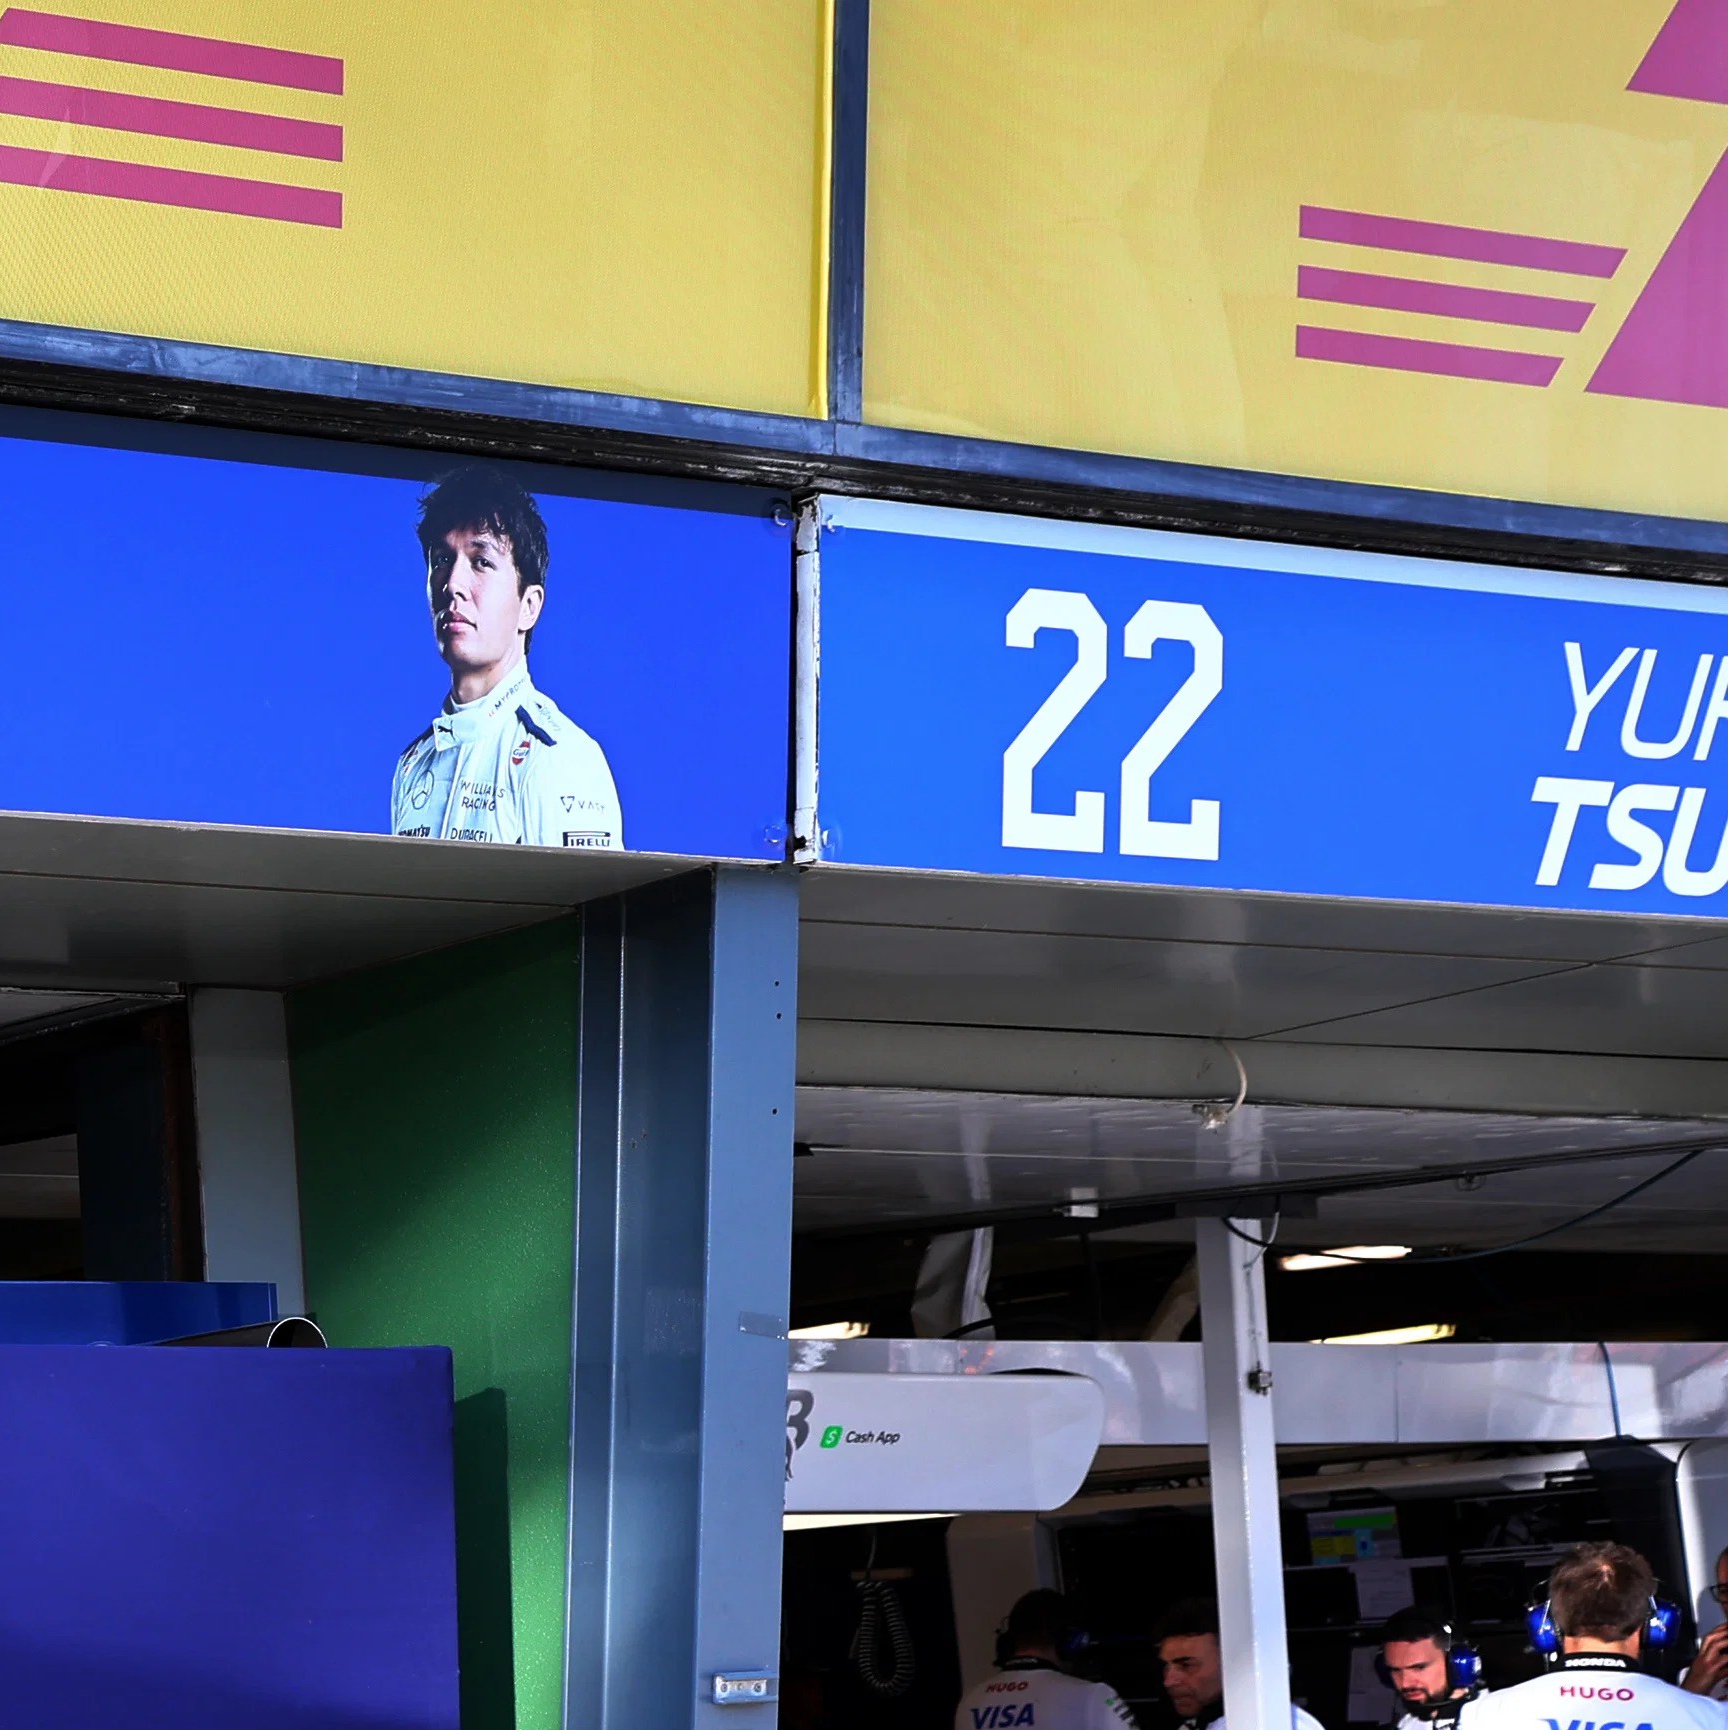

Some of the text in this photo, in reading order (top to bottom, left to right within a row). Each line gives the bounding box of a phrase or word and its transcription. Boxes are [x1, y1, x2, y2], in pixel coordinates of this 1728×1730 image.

[1002, 588, 1224, 862] 22
[461, 797, 496, 812] RACING
[845, 1430, 901, 1445] Cash App
[985, 1681, 1029, 1693] HUGO
[1559, 1685, 1635, 1702] HUGO
[970, 1703, 1034, 1730] VISA
